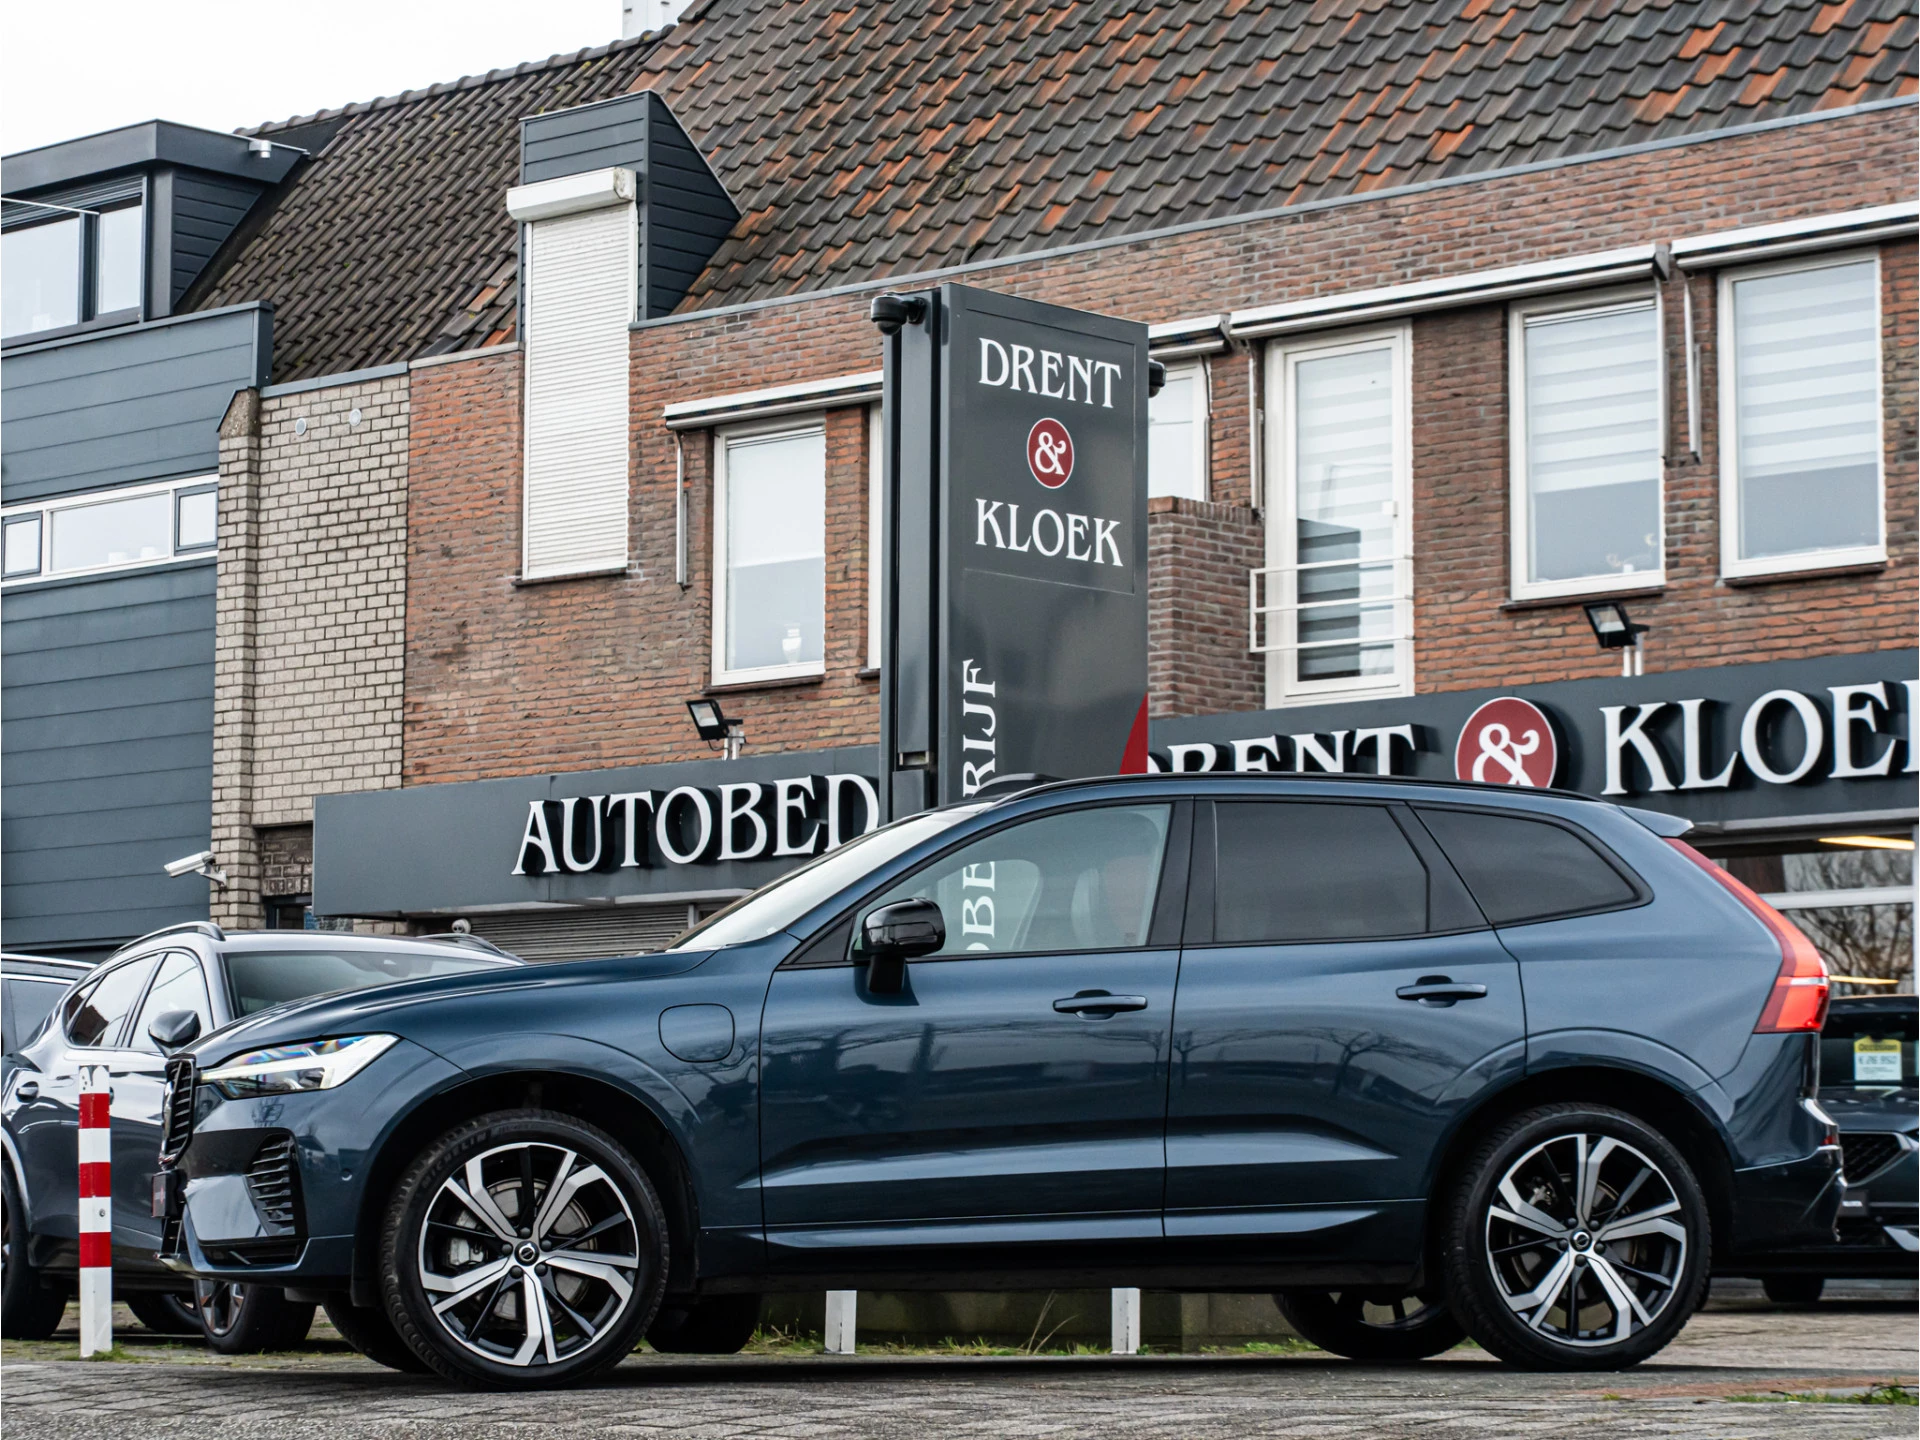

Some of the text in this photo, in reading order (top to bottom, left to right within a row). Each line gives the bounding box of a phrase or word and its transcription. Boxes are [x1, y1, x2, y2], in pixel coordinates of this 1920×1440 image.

[978, 337, 1122, 409] DRENT
[1034, 431, 1067, 476] &
[975, 498, 1124, 567] KLOEK
[1472, 723, 1540, 788] &
[1600, 679, 1918, 795] KLOE
